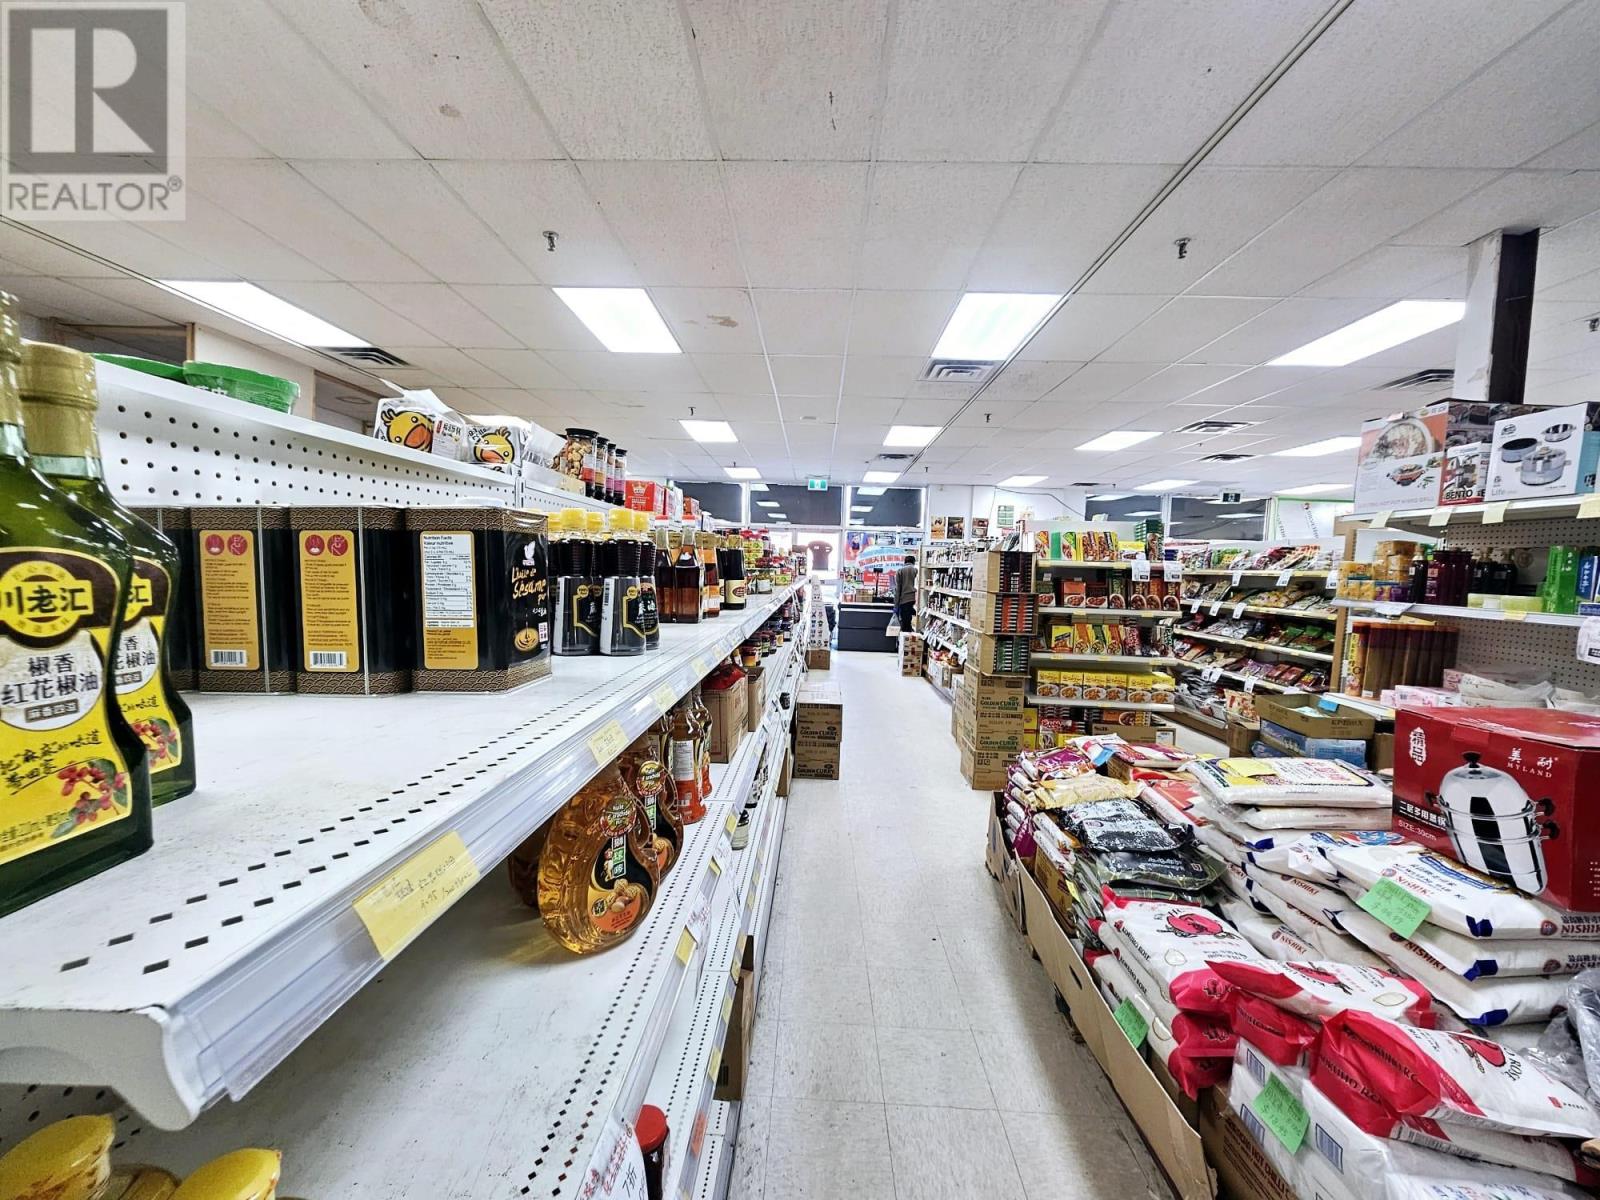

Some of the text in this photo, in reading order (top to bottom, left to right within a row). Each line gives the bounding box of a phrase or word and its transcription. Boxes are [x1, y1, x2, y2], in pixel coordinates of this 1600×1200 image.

[1445, 489, 1473, 500] BENTO
[28, 653, 75, 677] 椒香
[1, 672, 99, 706] 红花椒油
[1507, 762, 1552, 778] MYLAND
[1291, 878, 1320, 896] NISHIKI
[1280, 935, 1308, 955] NISHIKI
[1404, 941, 1448, 971] NISHIKI
[1251, 1147, 1265, 1166] HOT
